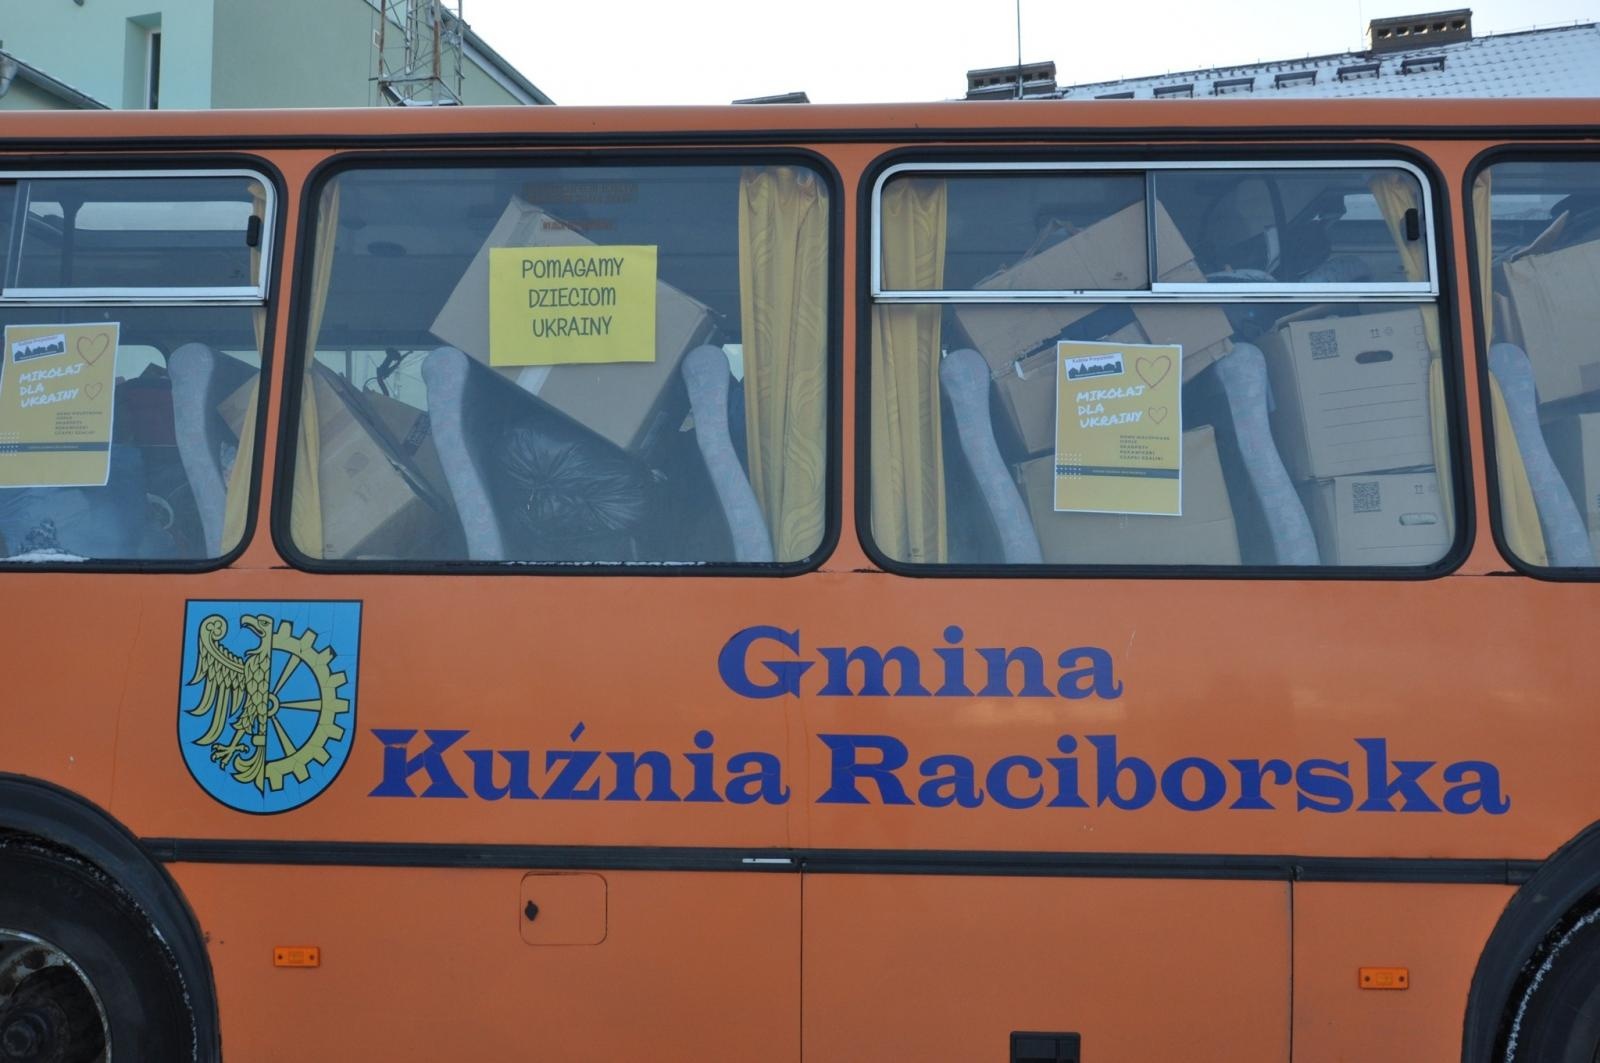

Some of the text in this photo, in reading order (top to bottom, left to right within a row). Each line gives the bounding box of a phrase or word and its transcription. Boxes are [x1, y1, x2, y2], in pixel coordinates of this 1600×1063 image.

[522, 257, 624, 279] POMAGAMY
[529, 287, 616, 308] DZIECIOM
[532, 315, 613, 338] UKRAINY
[19, 362, 84, 383] MIKOŁAJ
[20, 383, 45, 396] DLA
[20, 388, 80, 408] UKRAINY
[1076, 385, 1145, 402] MIKOŁAJ
[1077, 403, 1105, 416] DLA
[1079, 411, 1144, 428] UKRAINY
[718, 625, 1123, 699] Gmina
[368, 722, 1511, 815] Kuźnia Raciborska
